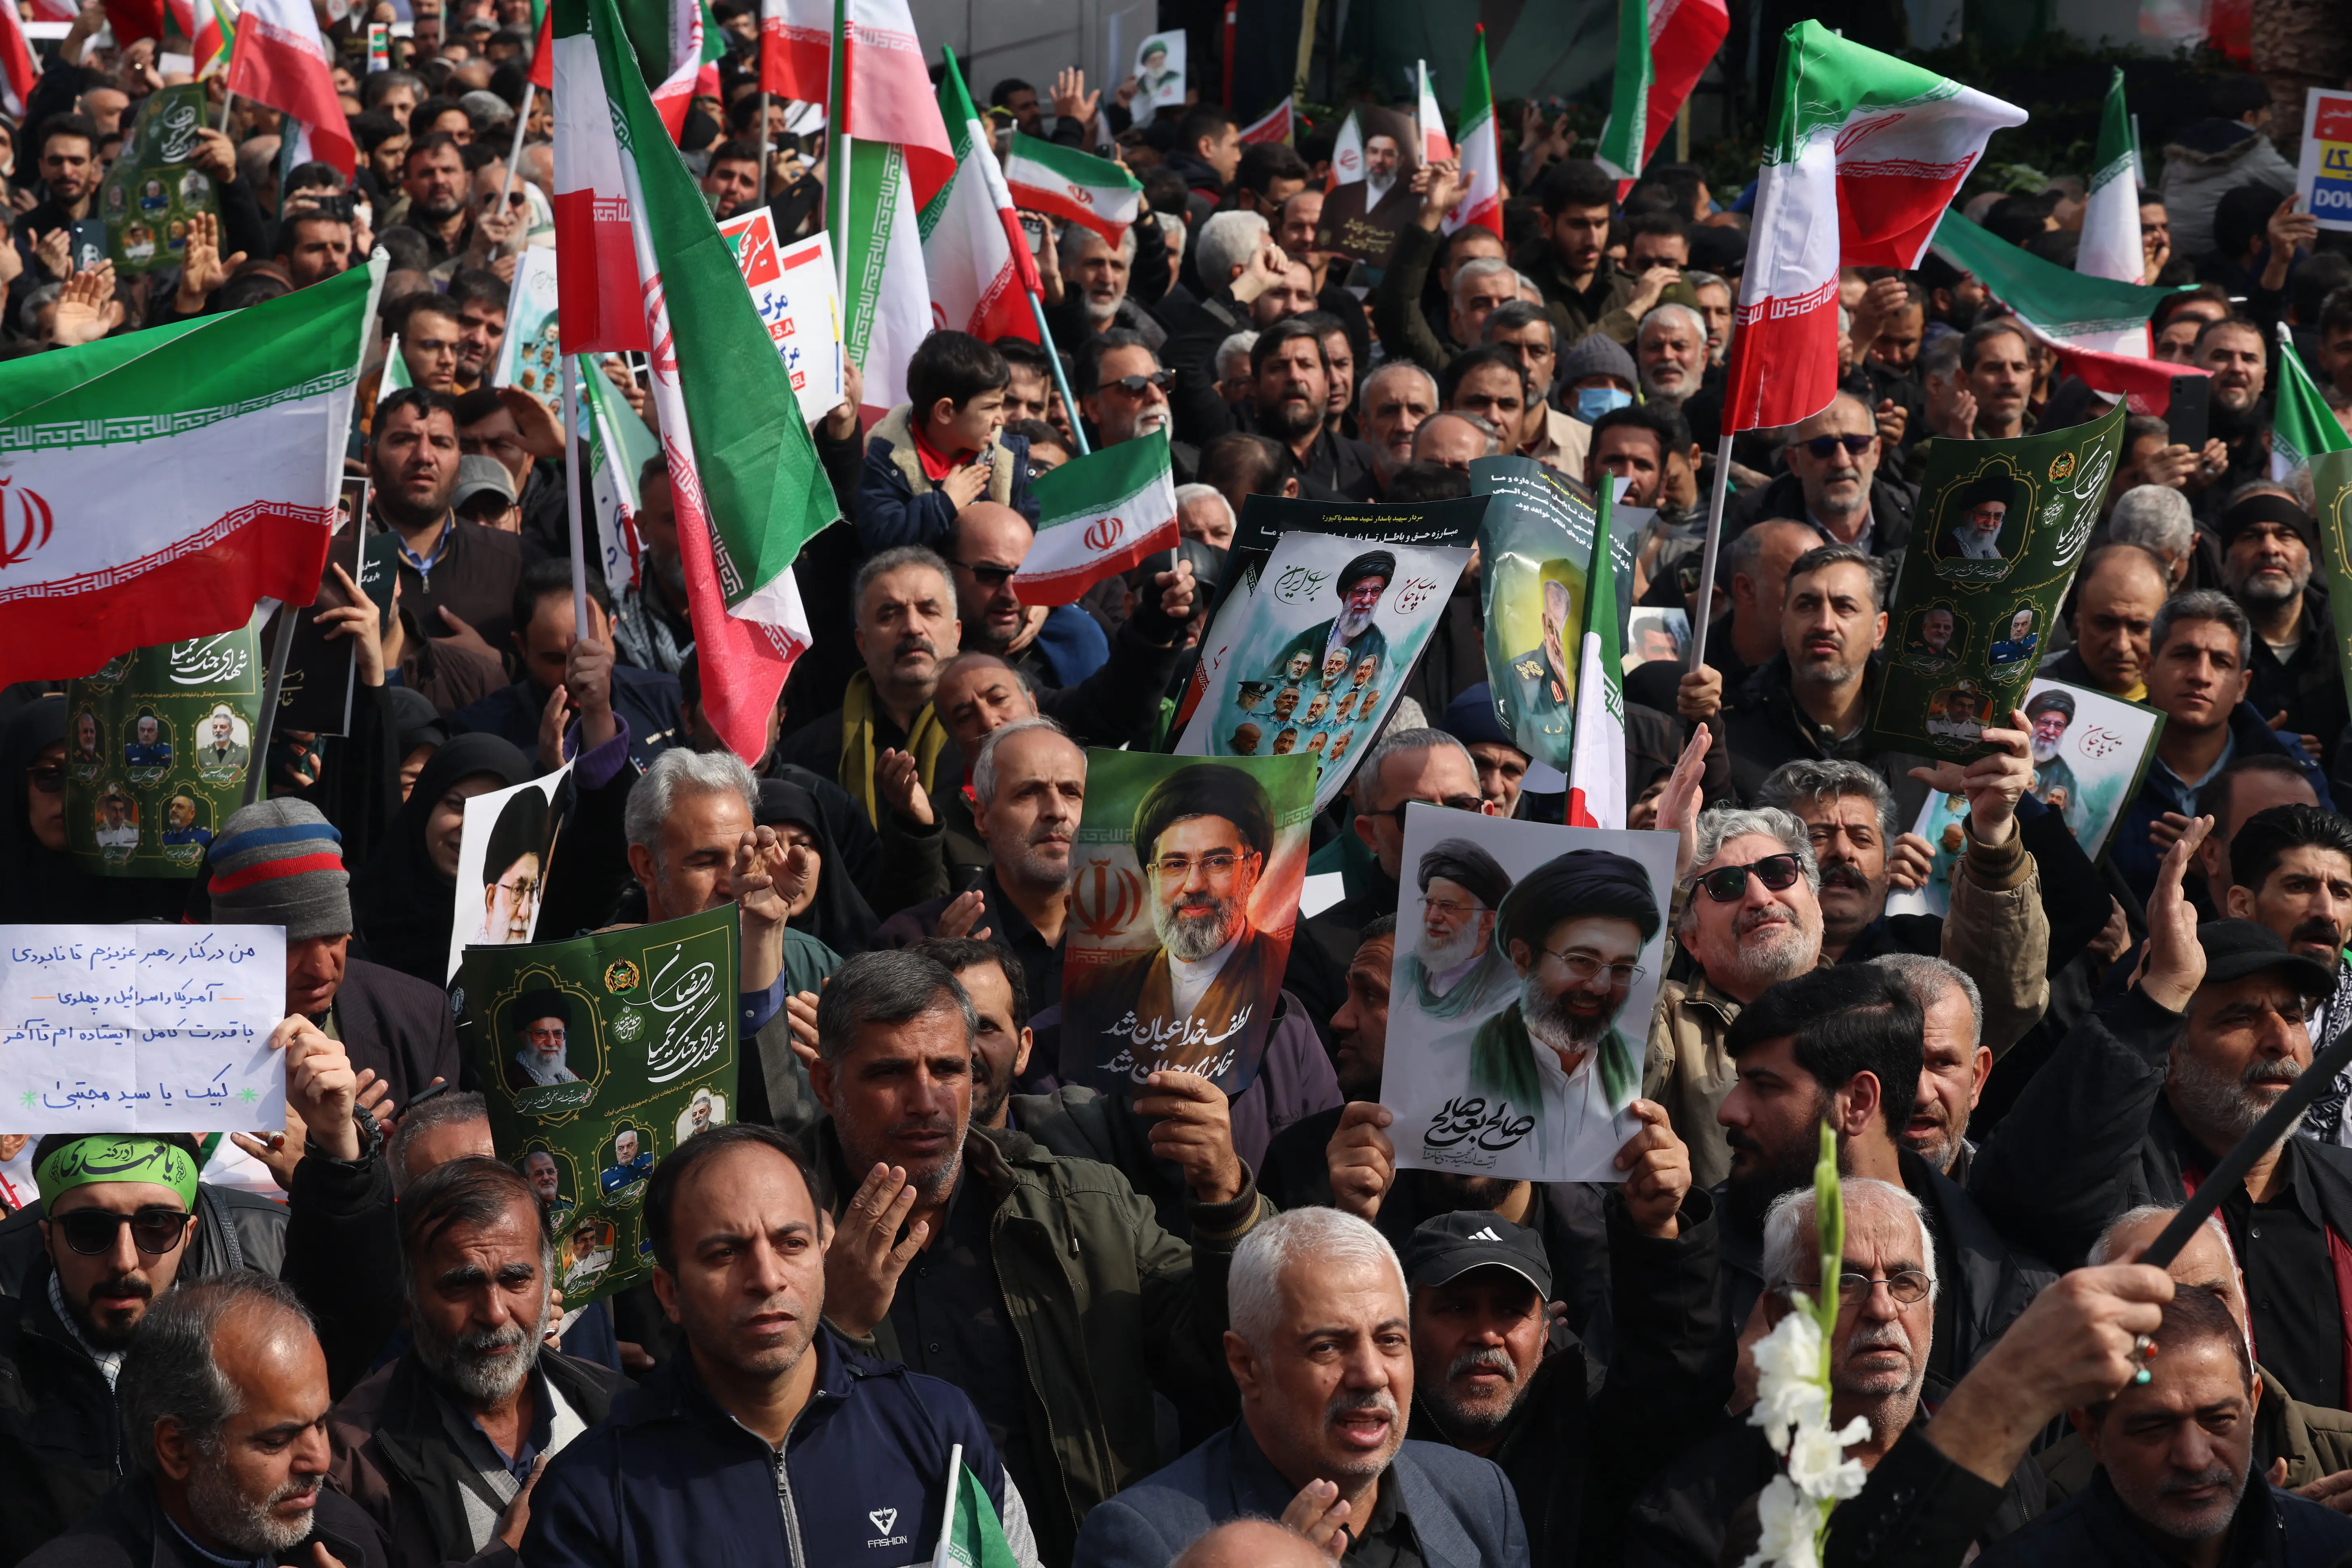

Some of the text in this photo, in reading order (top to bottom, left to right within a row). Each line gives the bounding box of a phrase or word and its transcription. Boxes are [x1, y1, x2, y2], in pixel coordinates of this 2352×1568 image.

[1261, 526, 1276, 535] ما
[1379, 533, 1404, 543] باطل
[1411, 532, 1430, 541] حق
[1432, 528, 1458, 539] مبارزه
[12, 933, 255, 971] من در کنار رهبر عزیزم تا نابودی
[114, 986, 163, 1008] اسرائیل
[164, 997, 170, 1005] و
[174, 978, 224, 1009] آمریکا
[58, 991, 99, 1015] پهلوی
[1100, 1010, 1137, 1036] شد
[1176, 1015, 1208, 1046] خدا
[3, 1018, 254, 1047] با قدرت کامل ایستاده ام تا آخر
[1131, 1015, 1184, 1051] عیان
[648, 1021, 725, 1082] شهدای
[1095, 1049, 1133, 1073] شد
[185, 1063, 232, 1106] لبیک
[660, 1086, 676, 1097] تبلیغات
[680, 1078, 694, 1089] فرهنگی
[118, 1091, 151, 1109] سید
[160, 1082, 172, 1106] یا
[579, 1088, 591, 1103] شهید
[631, 1098, 648, 1108] جمهوری
[648, 1093, 659, 1102] ارتش
[604, 1108, 614, 1116] ایران
[615, 1104, 630, 1114] اسلامی
[60, 1141, 166, 1177] مهدی
[867, 1535, 908, 1548] FASHION
